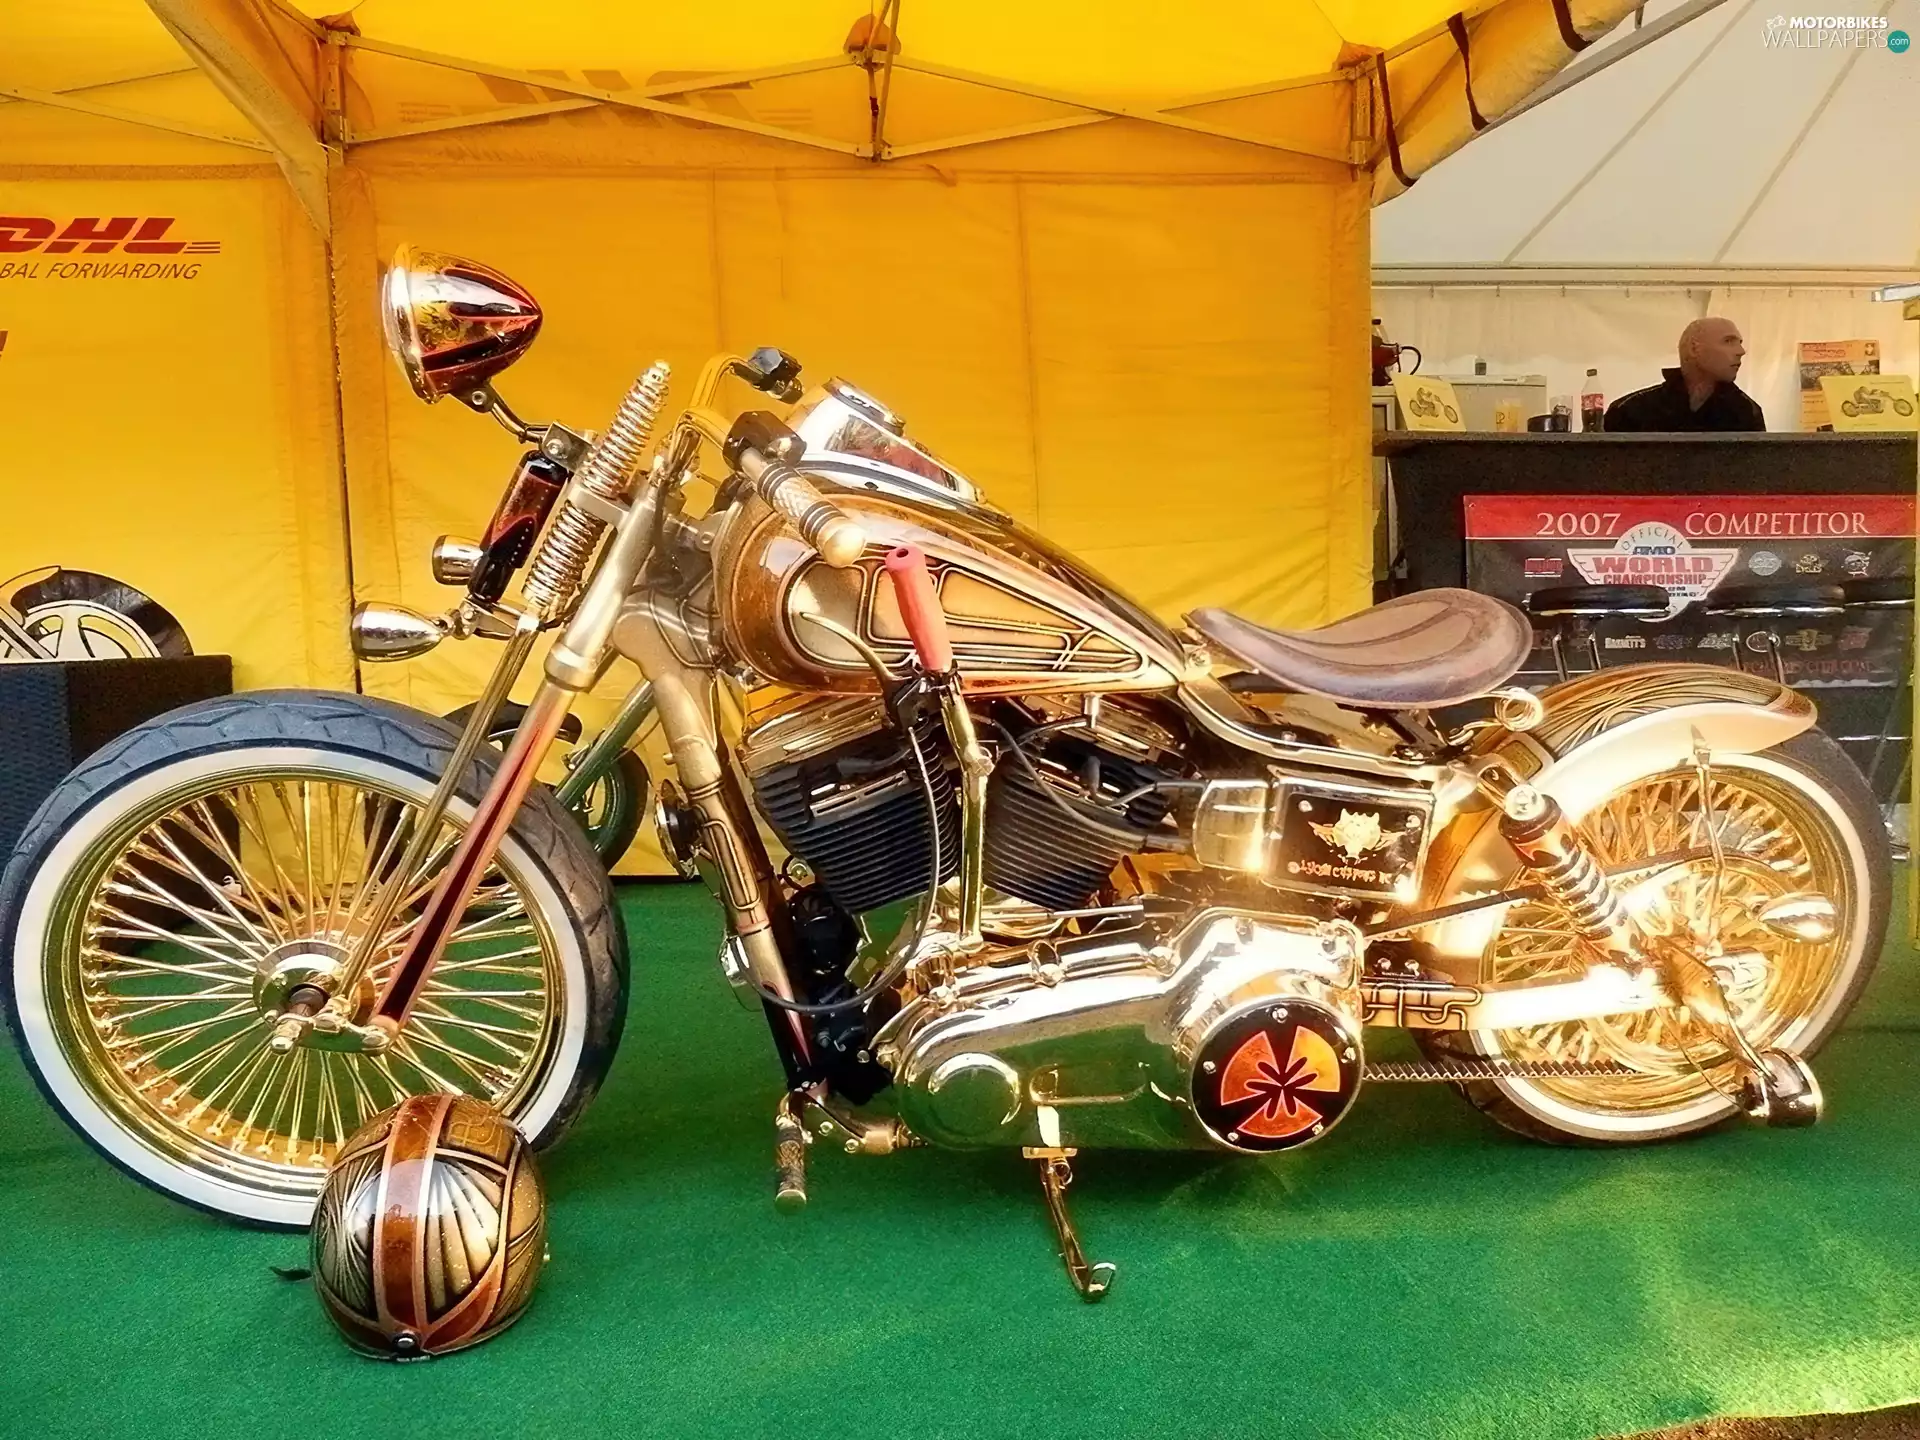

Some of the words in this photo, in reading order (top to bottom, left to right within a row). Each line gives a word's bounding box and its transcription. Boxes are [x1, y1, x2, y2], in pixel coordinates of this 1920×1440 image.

[0, 216, 188, 254] DHL
[45, 262, 202, 280] FORWARDING
[1536, 512, 1621, 536] 2007
[1684, 512, 1869, 535] COMPETITOR
[1621, 526, 1685, 551] OFFICIAL
[1592, 557, 1714, 574] WORLD
[1603, 573, 1707, 585] CHAMPIONSHIP
